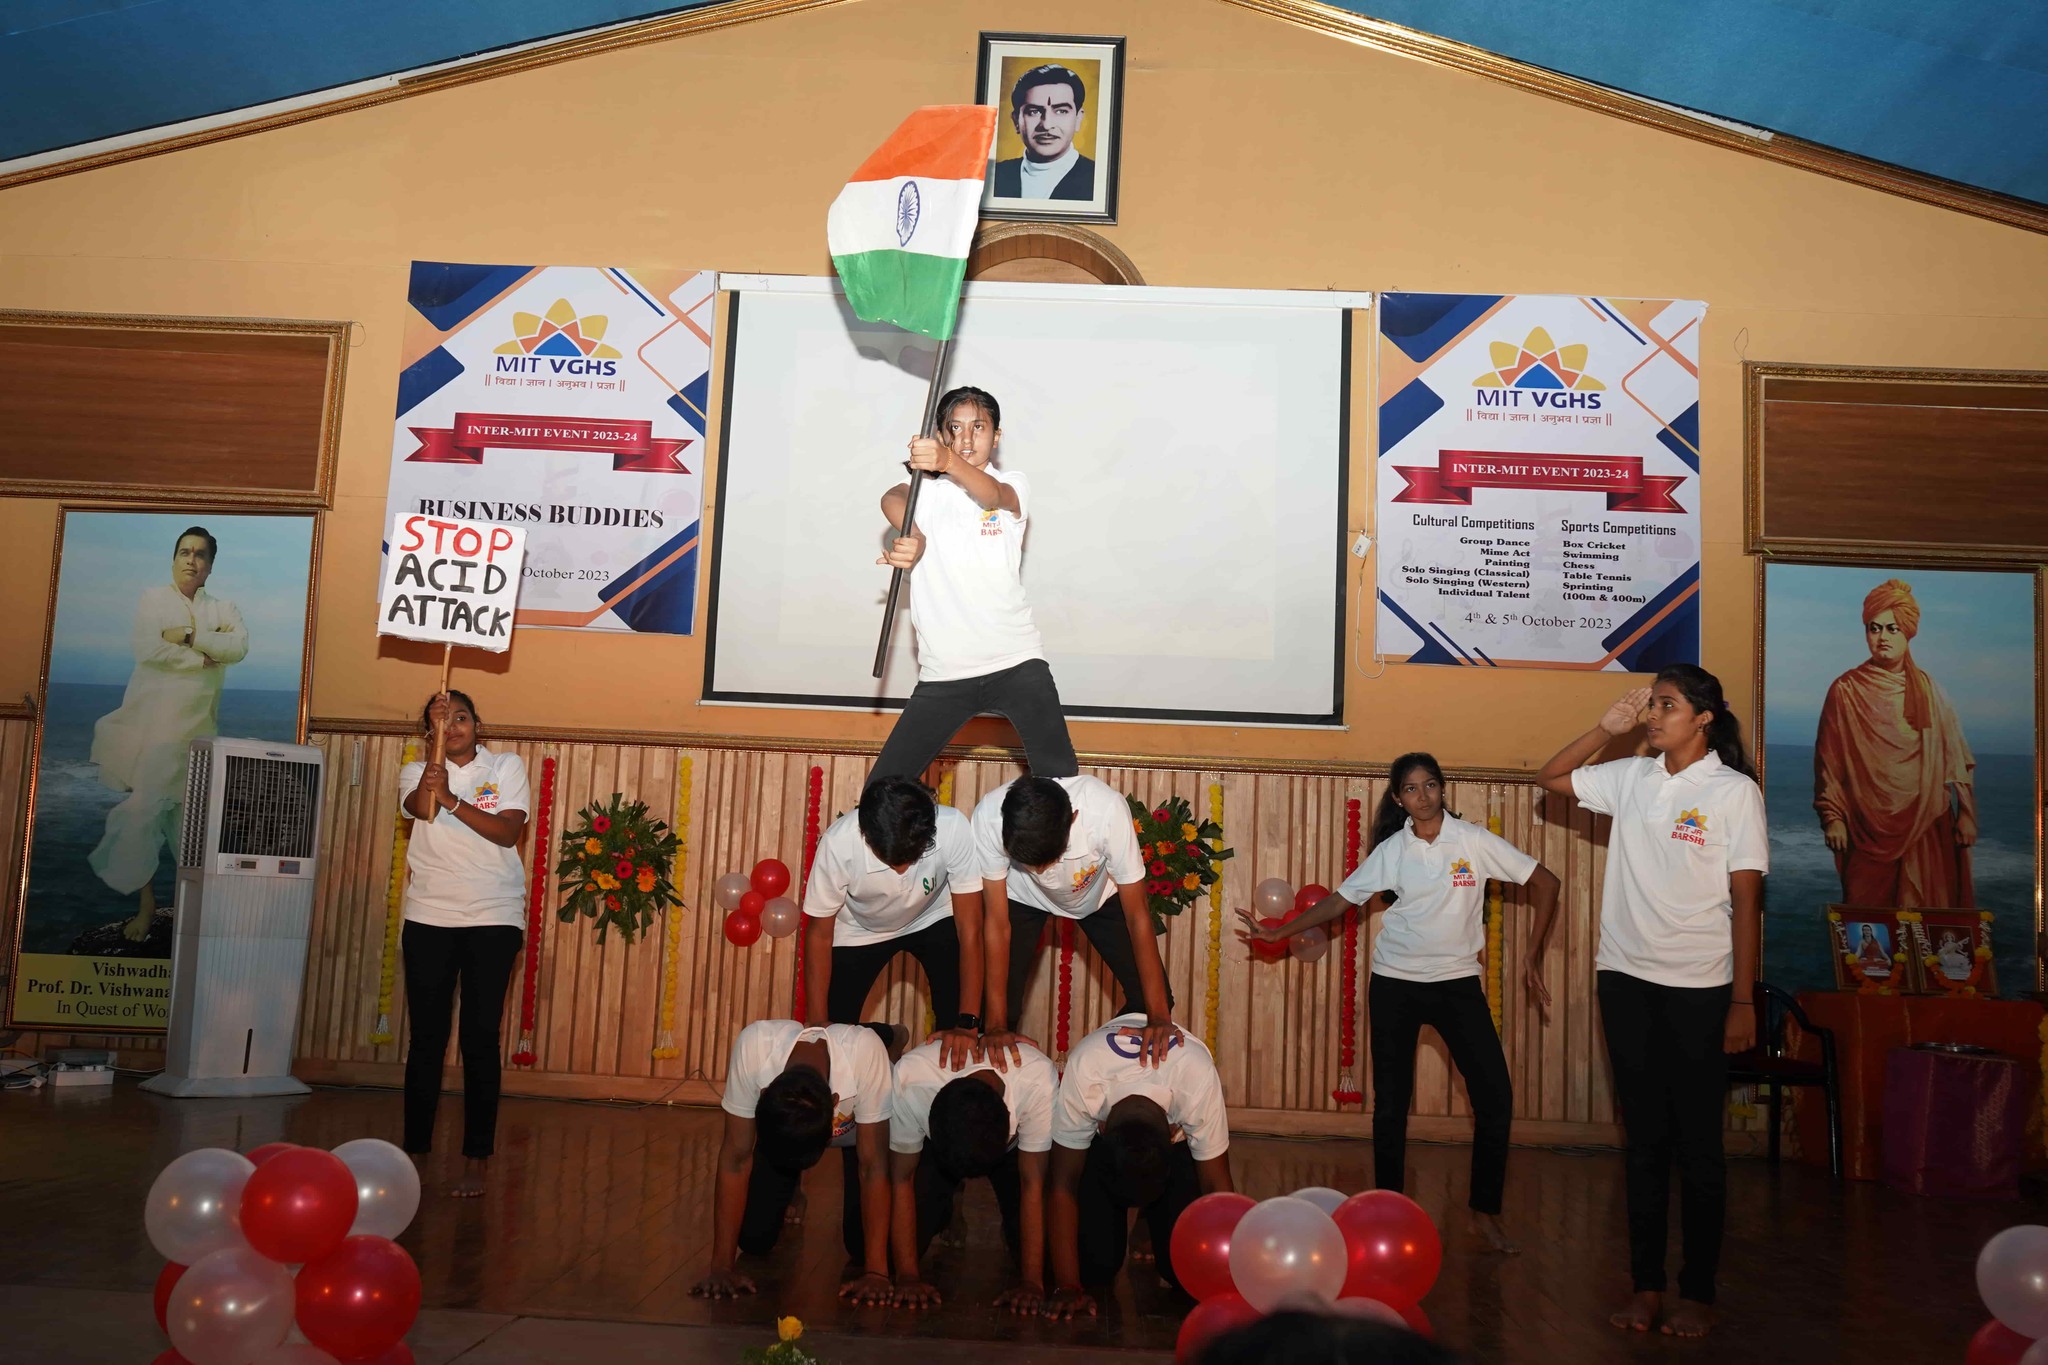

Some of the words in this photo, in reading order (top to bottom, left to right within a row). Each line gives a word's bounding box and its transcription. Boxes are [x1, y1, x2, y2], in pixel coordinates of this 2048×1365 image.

[496, 356, 541, 372] MIT
[549, 359, 617, 376] VGHS
[556, 380, 587, 390] अनुभव
[1477, 389, 1523, 407] MIT
[1531, 392, 1602, 409] VGHS
[1541, 414, 1572, 425] अनुभव
[467, 425, 541, 437] INTER-MIT
[544, 428, 590, 439] EVENT
[593, 431, 638, 441] 2023-24
[1453, 463, 1529, 475] INTER-MIT
[1532, 466, 1580, 477] EVENT
[1583, 468, 1630, 479] 2023-24
[419, 498, 542, 523] BUSINESS
[548, 504, 664, 529] BUDDIES
[1413, 513, 1458, 527] Cultural
[1461, 516, 1535, 531] Competitions
[1561, 519, 1600, 534] Sports
[1603, 521, 1677, 536] Competitions
[400, 515, 513, 563] STOP
[1459, 537, 1493, 547] Group
[1496, 538, 1531, 547] Dance
[1563, 540, 1584, 548] Box
[1587, 541, 1626, 550] Cricket
[1480, 548, 1509, 556] Mime
[1512, 549, 1531, 557] Act
[1563, 551, 1620, 561] Swimming
[1485, 559, 1530, 569] Painting
[1563, 561, 1595, 569] Chess
[394, 553, 507, 595] ACID
[521, 566, 574, 580] October
[577, 569, 610, 581] 2023
[1401, 565, 1426, 573] Solo
[1428, 566, 1470, 576] Singing
[1474, 568, 1530, 579] (Classical)
[1563, 572, 1593, 580] Table
[1596, 573, 1632, 581] Tennis
[1405, 576, 1430, 584] Solo
[1432, 577, 1475, 587] Singing
[1478, 579, 1530, 589] (Western)
[1563, 582, 1614, 592] Sprinting
[1438, 588, 1493, 597] Individual
[1496, 590, 1530, 599] Talent
[1562, 592, 1596, 601] (100m
[1599, 594, 1608, 602] &
[1611, 595, 1647, 603] 400m)
[388, 593, 511, 637] ATTACK
[1465, 612, 1481, 623] 4th
[1485, 613, 1497, 625] &
[1502, 614, 1518, 625] 5th
[1521, 615, 1576, 628] October
[1579, 617, 1612, 629] 2023
[1671, 831, 1706, 846] BARSHI
[27, 979, 64, 994] Prof.
[70, 980, 93, 995] Dr.
[57, 1000, 71, 1014] In
[76, 1000, 118, 1018] Quest
[123, 1003, 140, 1017] of
[143, 1003, 168, 1018] Wo
